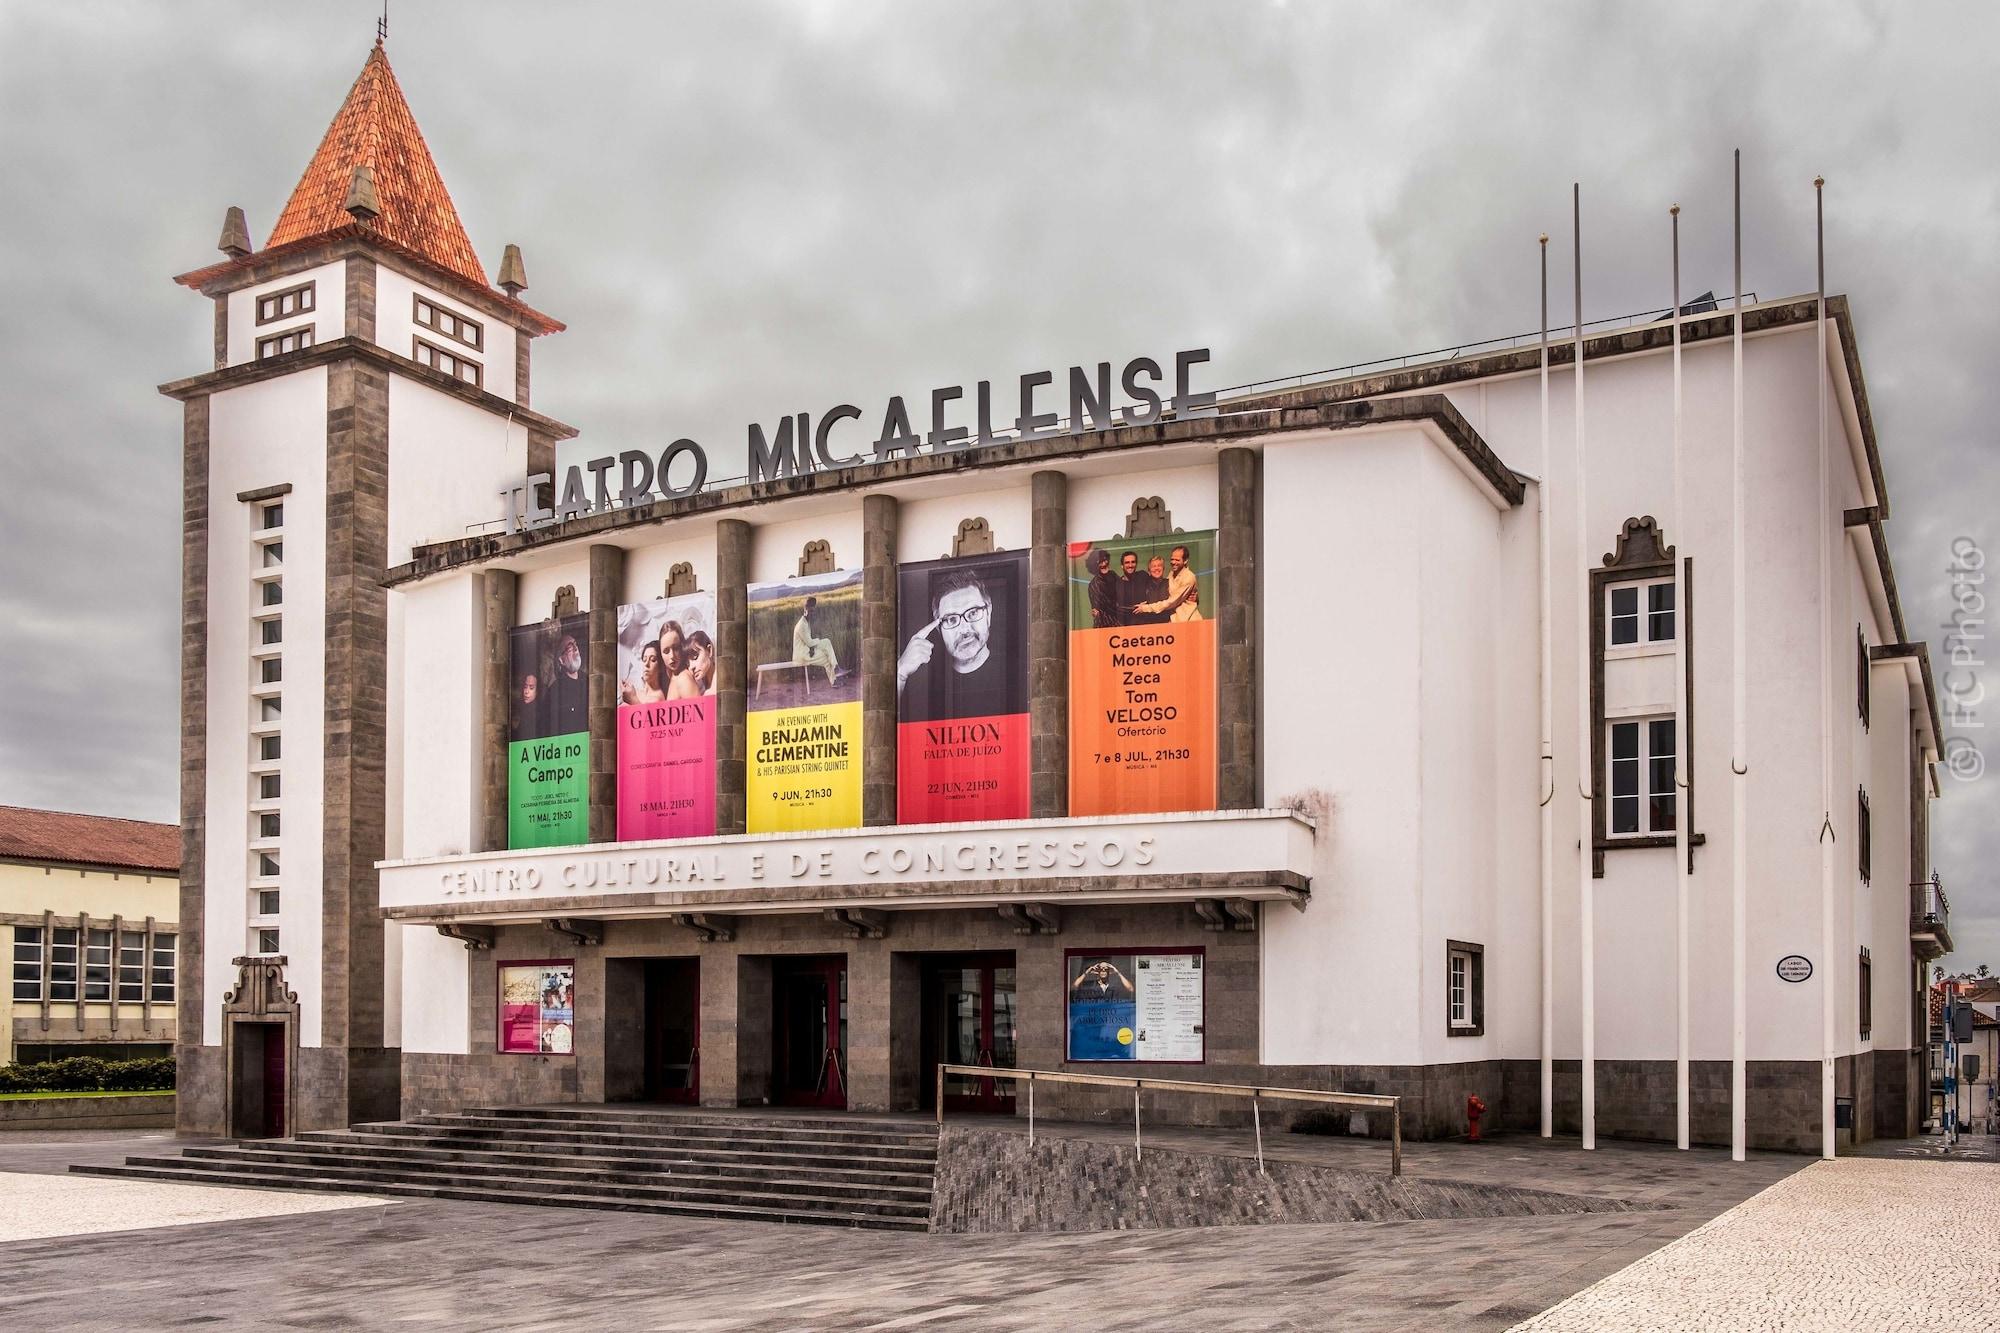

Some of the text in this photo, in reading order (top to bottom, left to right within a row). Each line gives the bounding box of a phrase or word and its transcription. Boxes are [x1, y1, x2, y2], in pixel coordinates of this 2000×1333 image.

[499, 347, 1217, 535] TEATRO MICAELENSE
[1109, 634, 1175, 649] Caetano
[1112, 654, 1171, 667] Moreno
[1123, 671, 1161, 685] Zeca
[1126, 690, 1157, 703] Tom
[630, 703, 705, 730] GARDEN
[777, 713, 828, 727] AN EVENING WITH
[1106, 706, 1177, 723] VELOSO
[668, 728, 683, 737] NAP
[762, 724, 841, 746] BENJAMIN
[926, 722, 1000, 746] NILTON
[1117, 725, 1166, 737] Ofertório
[521, 743, 581, 763] A Vida no
[756, 742, 848, 763] CLEMENTINE
[924, 745, 1001, 760] FALTA DE JUÍZO
[1094, 753, 1101, 764] 7
[1114, 752, 1121, 763] 8
[1155, 749, 1190, 761] 21h30
[528, 767, 573, 784] Campo
[757, 760, 849, 776] & HIS PARISIAN STRING QUINTET
[773, 792, 778, 800] 9
[805, 788, 832, 799] 21h30
[927, 783, 939, 794] 22
[966, 780, 998, 792] 21H30
[640, 803, 648, 812] 18
[670, 799, 695, 809] 21H30
[528, 814, 535, 823] 11
[553, 810, 573, 821] 21h30
[440, 838, 1155, 895] CENTRO CULTURAL E DE CONGRESSOS
